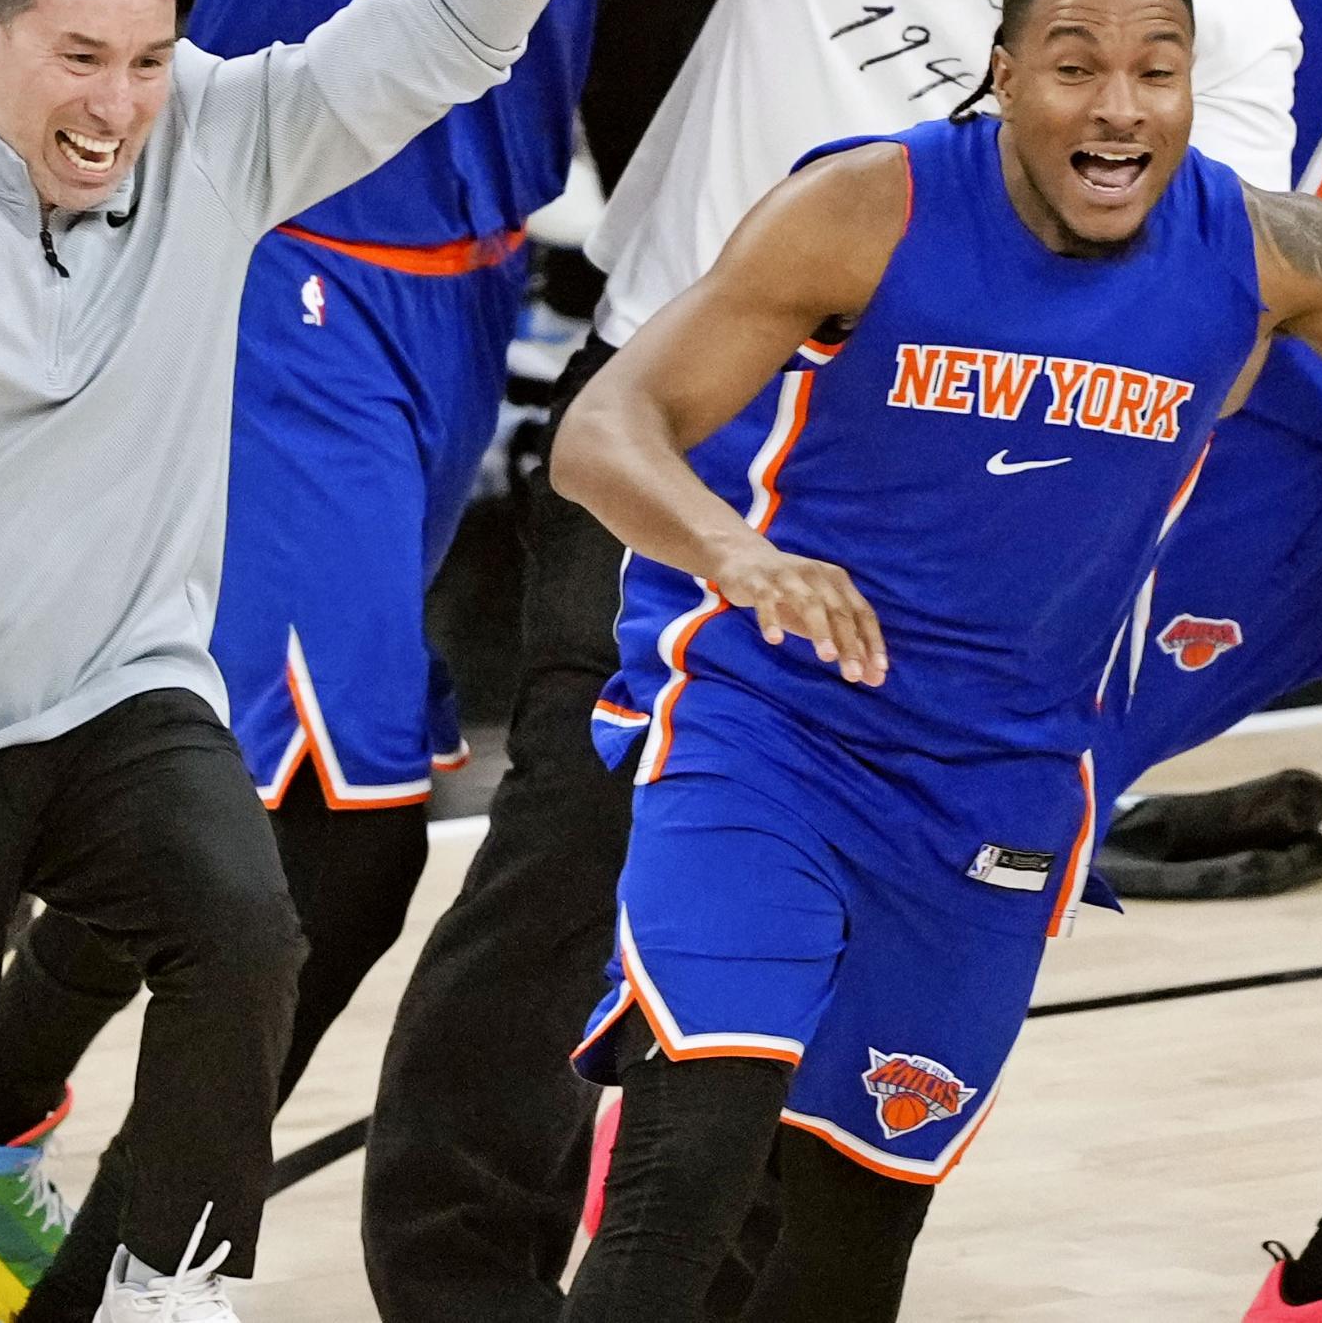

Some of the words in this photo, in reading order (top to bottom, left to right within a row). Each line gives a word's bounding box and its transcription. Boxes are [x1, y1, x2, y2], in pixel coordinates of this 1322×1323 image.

[829, 4, 977, 101] 194
[887, 343, 1044, 421] NEW
[1044, 356, 1196, 444] YORK
[866, 1057, 961, 1114] KNICKS
